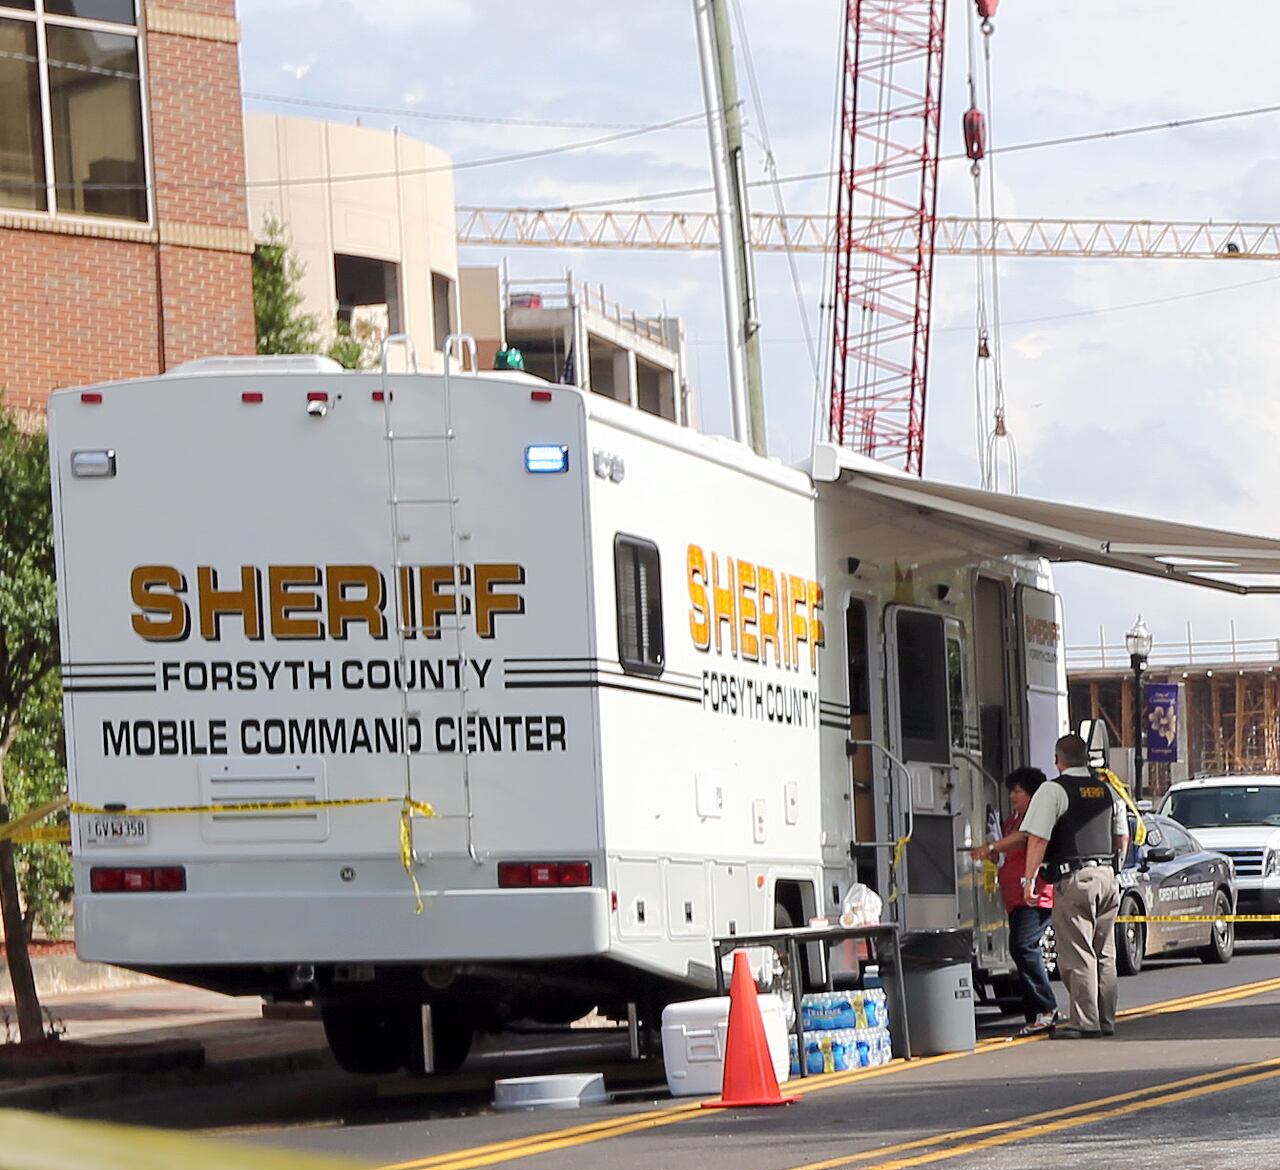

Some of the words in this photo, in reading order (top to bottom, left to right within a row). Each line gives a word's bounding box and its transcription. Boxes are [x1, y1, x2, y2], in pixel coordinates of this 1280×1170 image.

[130, 563, 525, 642] SHERIFF
[687, 543, 825, 676] SHERIFF
[162, 661, 332, 691] FORSYTH
[342, 658, 491, 690] COUNTY
[702, 669, 764, 721] FORSYTH
[766, 682, 817, 730] COUNTY
[102, 720, 228, 756] MOBILE
[240, 717, 422, 754] COMMAND
[435, 716, 566, 753] CENTER
